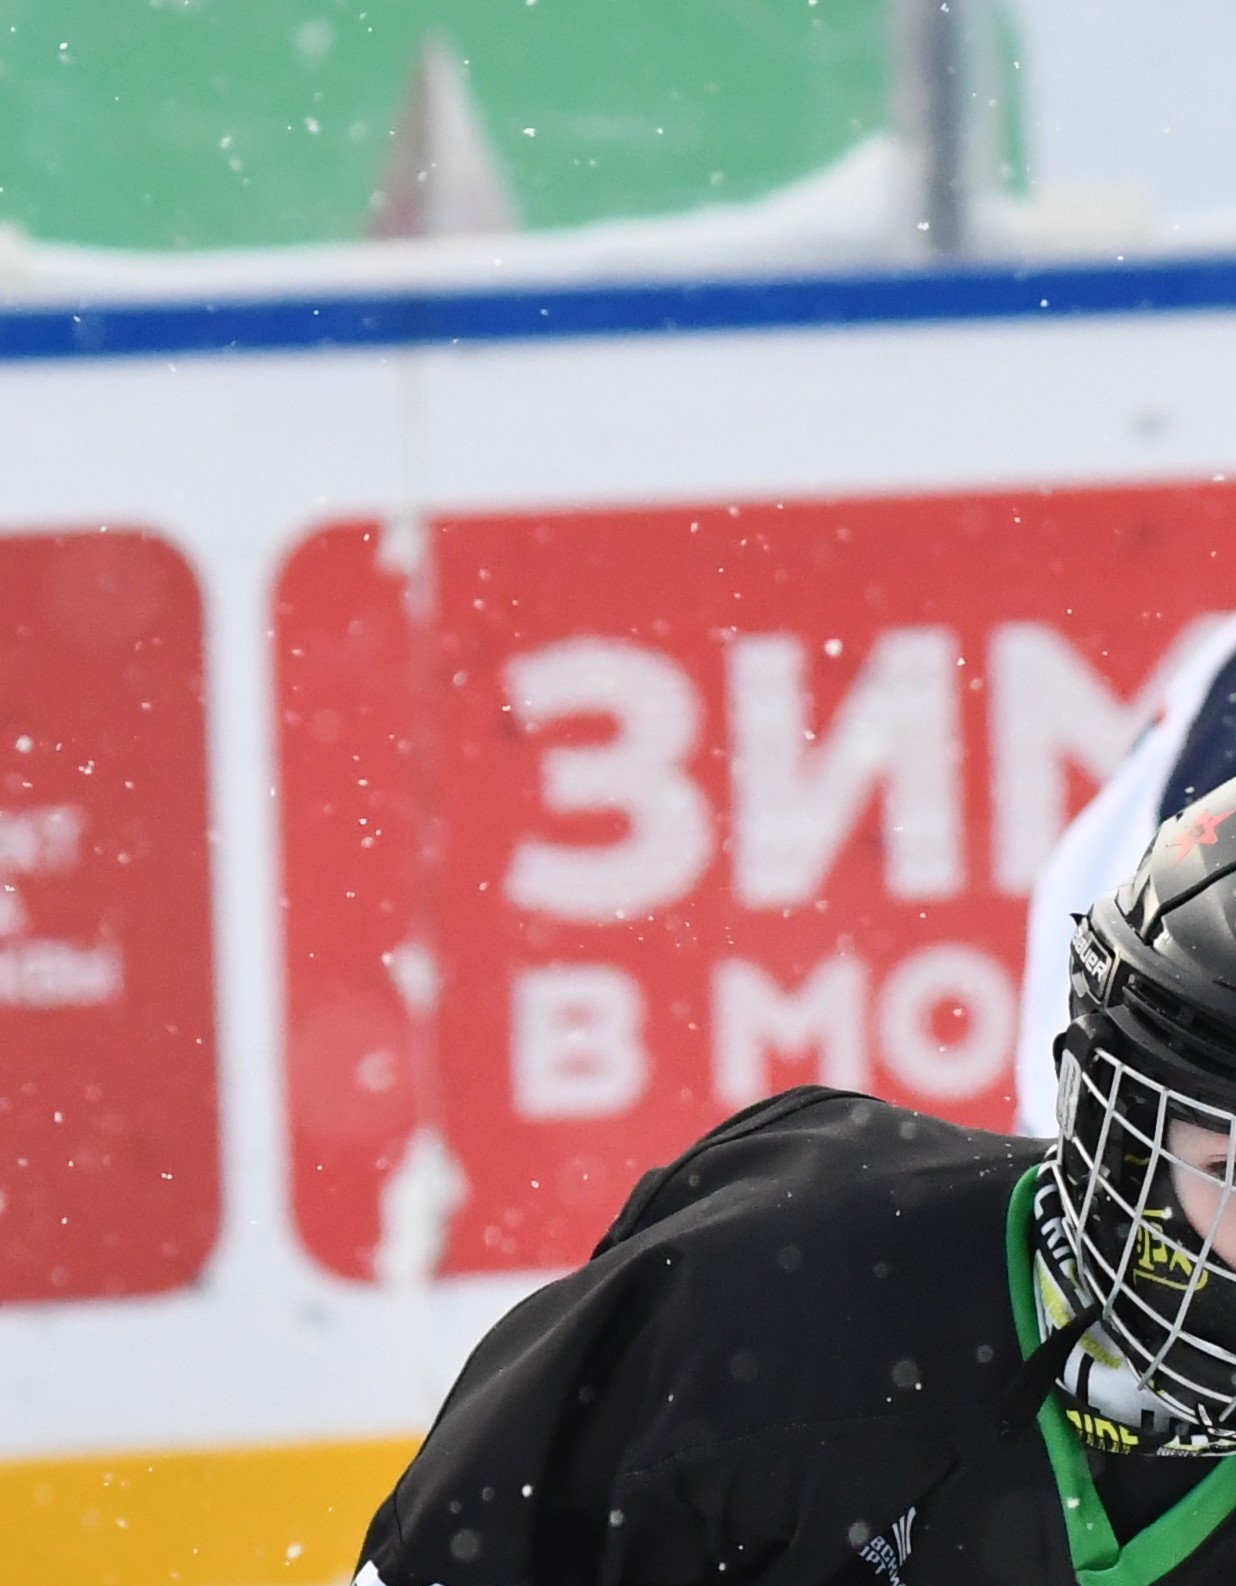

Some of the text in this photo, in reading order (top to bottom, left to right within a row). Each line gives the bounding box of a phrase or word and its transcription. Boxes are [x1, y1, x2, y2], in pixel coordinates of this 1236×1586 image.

[503, 612, 1236, 925] ЗИМ
[511, 944, 1020, 1120] В МО
